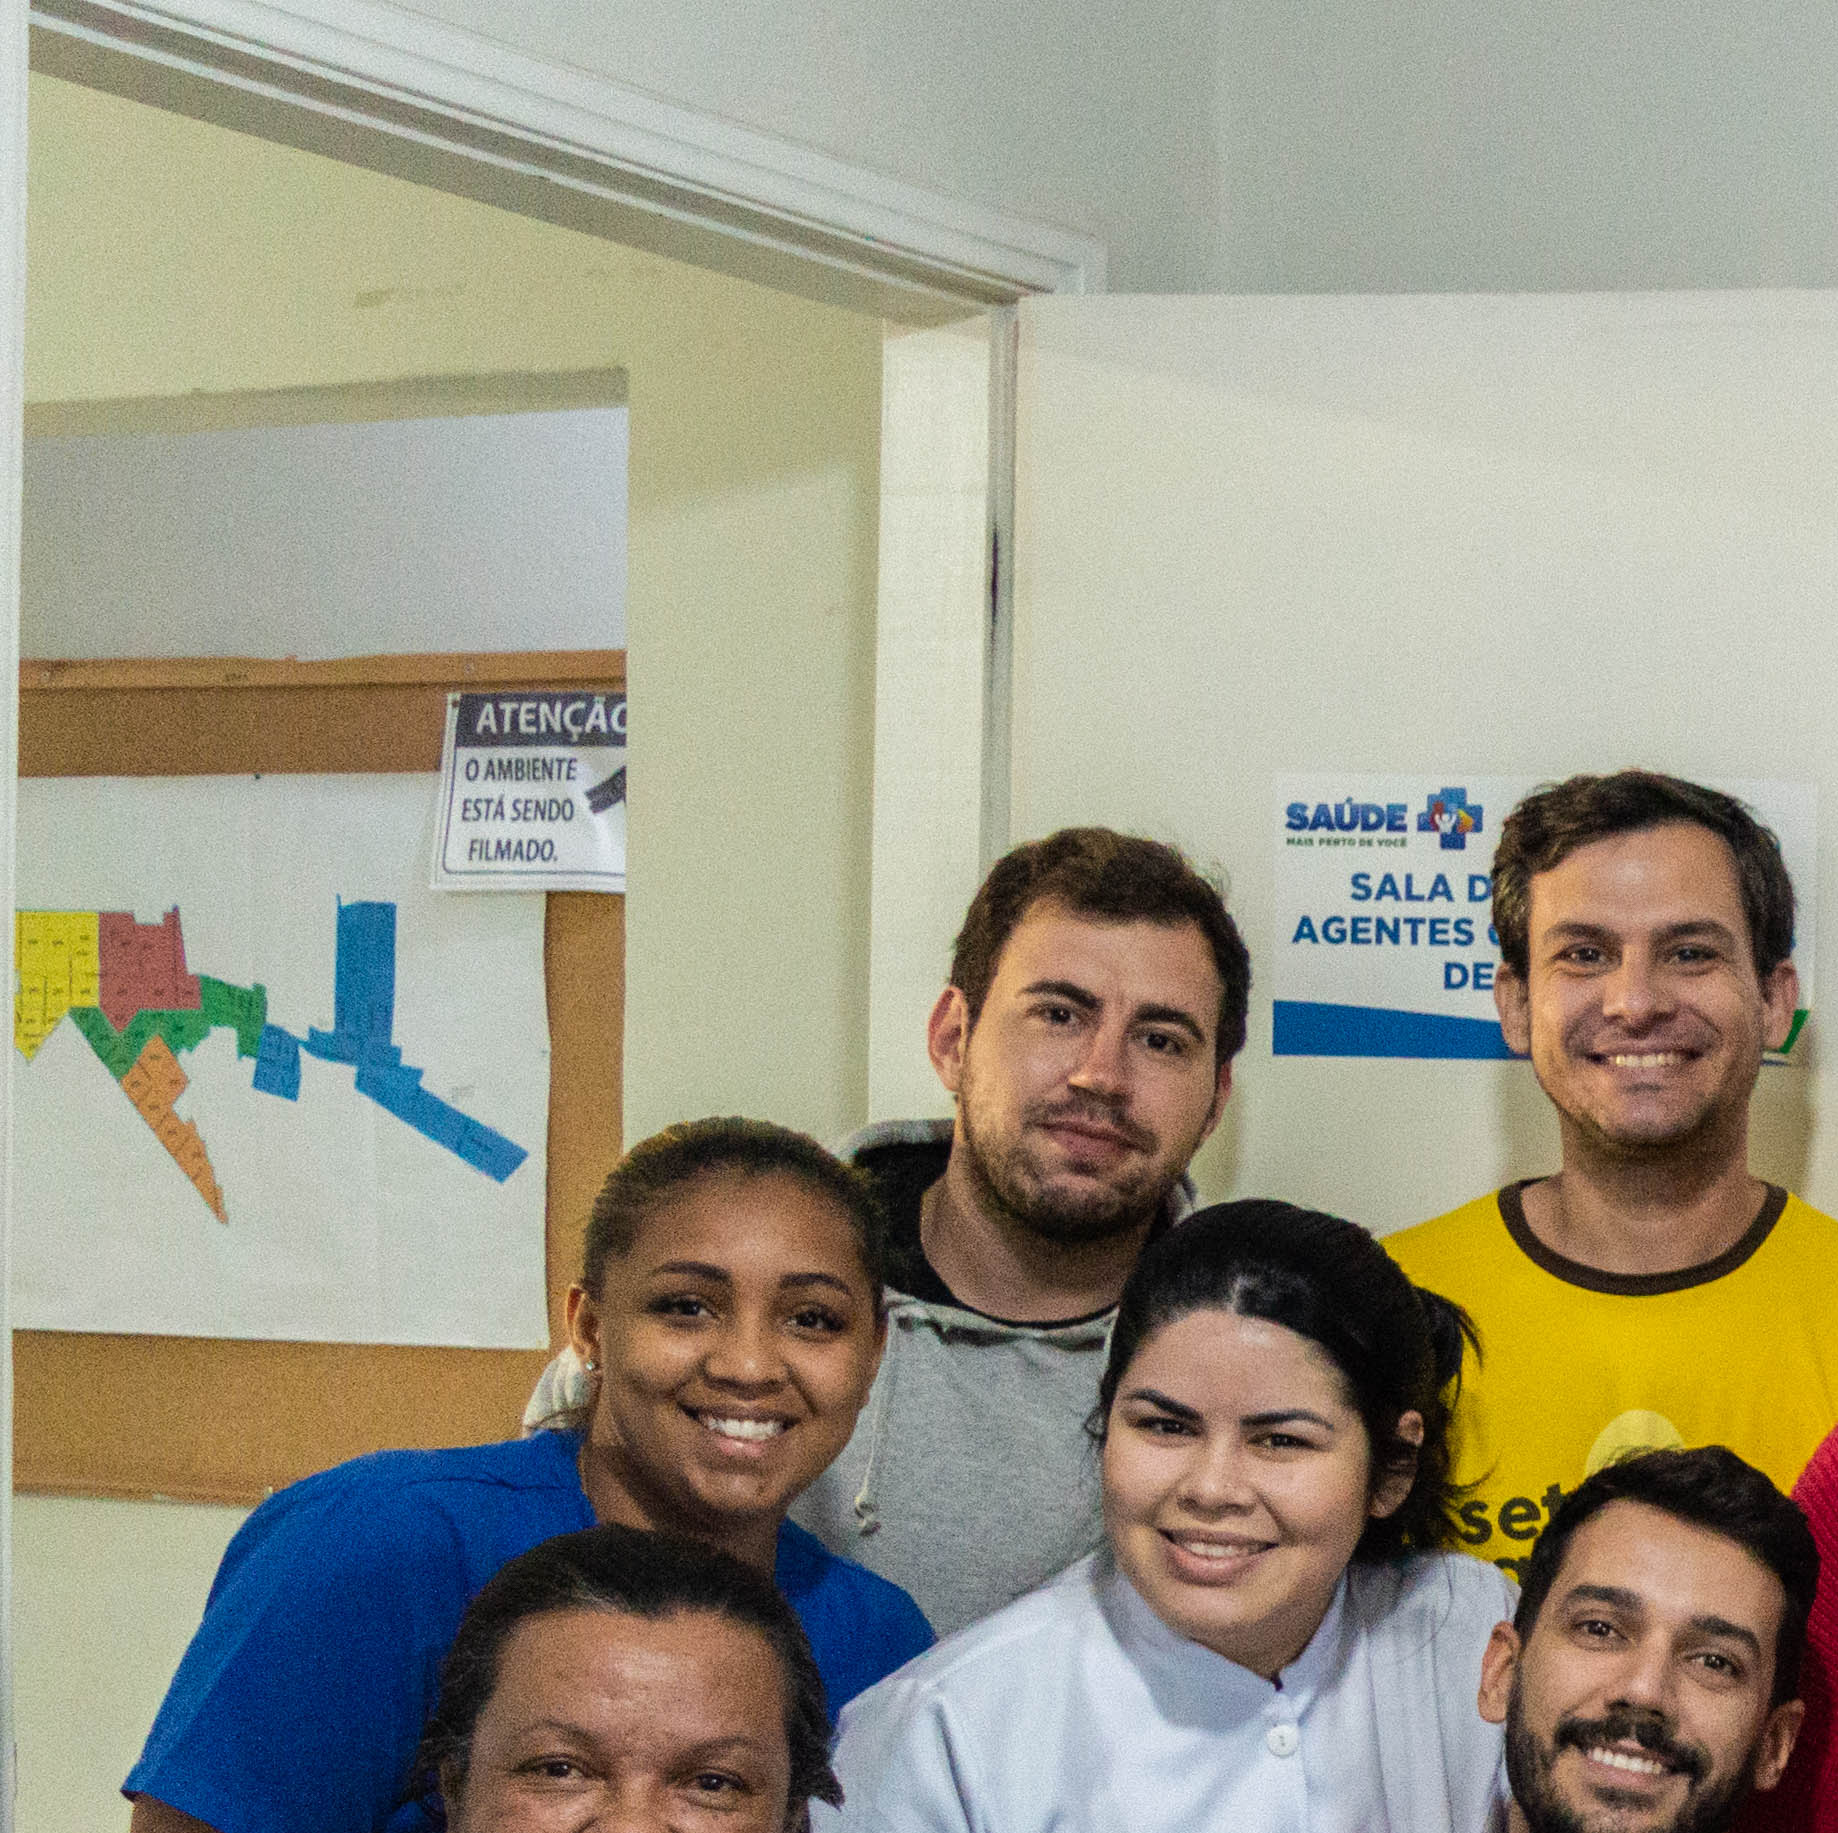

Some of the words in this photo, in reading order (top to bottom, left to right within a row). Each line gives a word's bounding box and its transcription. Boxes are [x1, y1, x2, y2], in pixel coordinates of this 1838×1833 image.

[465, 759, 479, 781] O
[484, 758, 578, 781] AMBIENTE
[461, 793, 505, 821] ESTÁ
[511, 799, 575, 821] SENDO
[1286, 797, 1408, 833] SAÚDE
[468, 838, 558, 863] FILMADO.
[1286, 837, 1314, 847] MAIS
[1319, 837, 1356, 847] PERTO
[1359, 837, 1373, 847] DE
[1351, 872, 1454, 902] SALA
[1468, 873, 1493, 902] D
[1292, 915, 1475, 947] AGENTES
